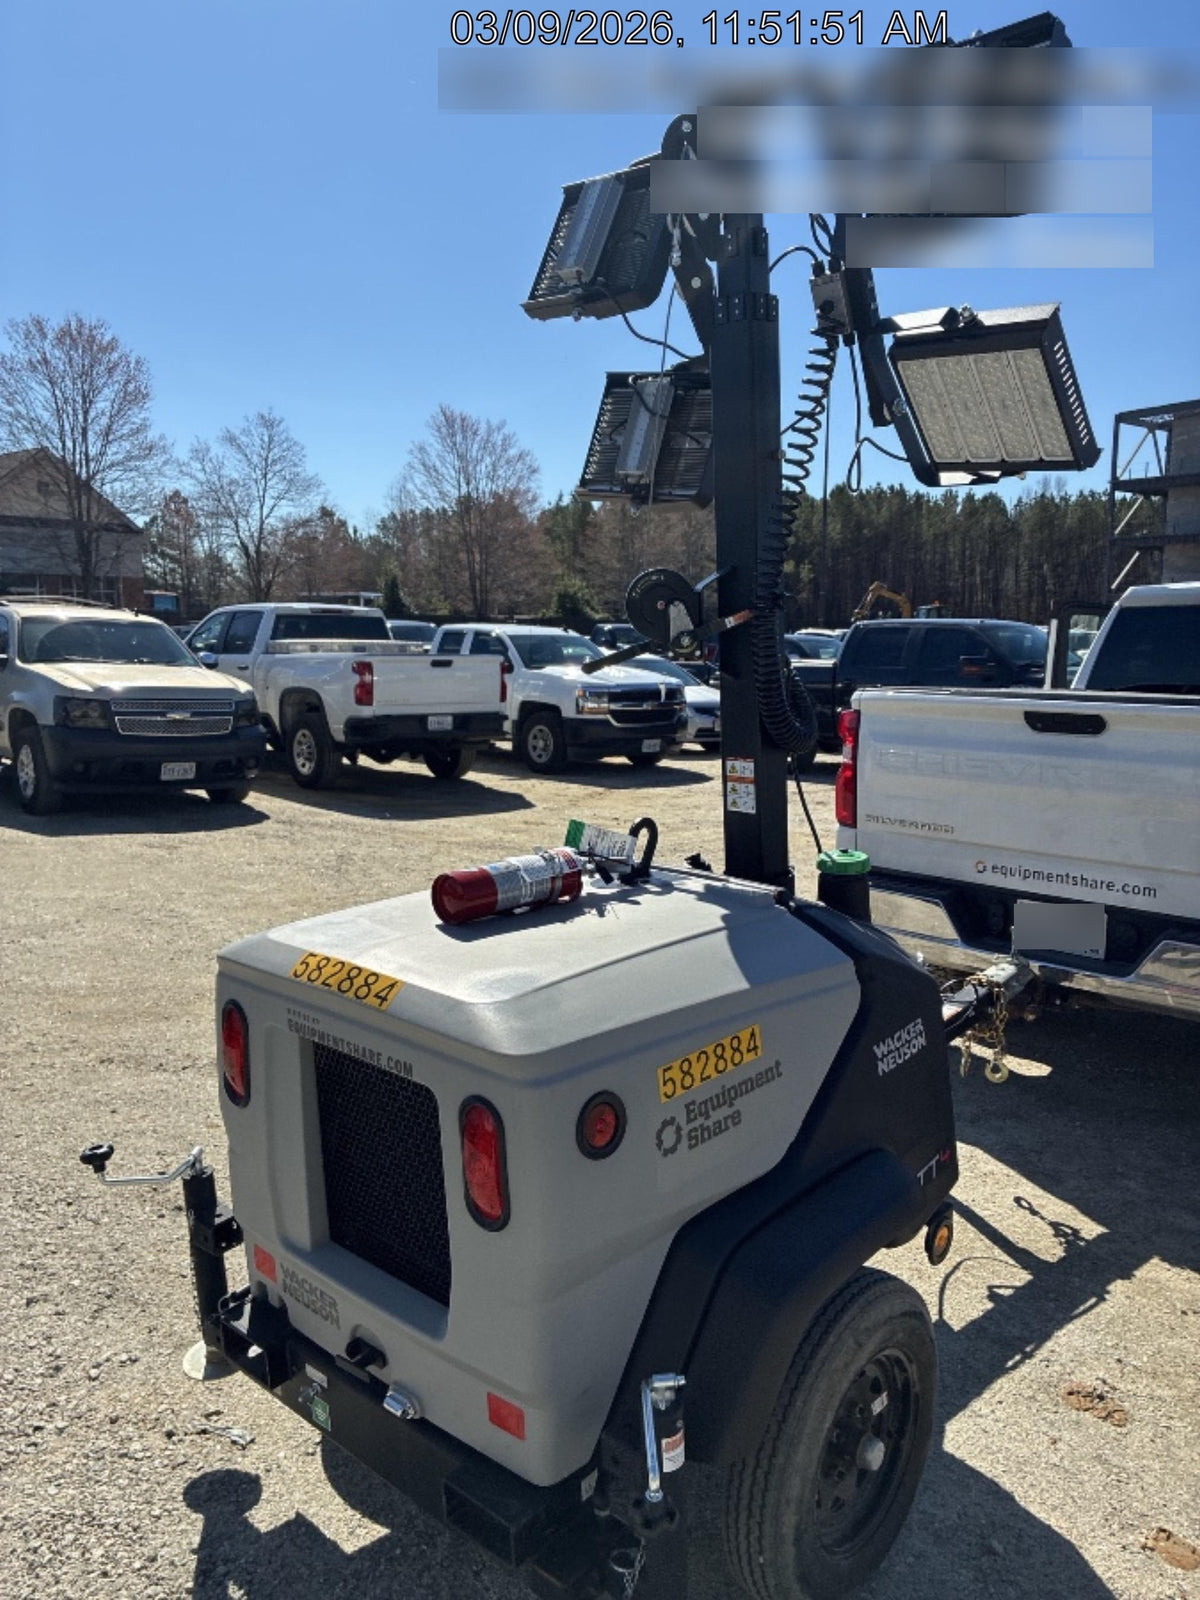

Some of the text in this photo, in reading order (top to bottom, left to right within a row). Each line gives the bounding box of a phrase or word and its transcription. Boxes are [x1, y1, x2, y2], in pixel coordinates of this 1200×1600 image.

[991, 864, 1158, 898] equipmentshare.com
[292, 952, 399, 1007] 582884
[287, 1018, 414, 1078] EQUIPMENTSHARE.COM
[662, 1027, 759, 1099] 582884
[872, 1017, 924, 1059] WACKER
[877, 1031, 926, 1076] NEUSON
[684, 1059, 783, 1125] Equipment
[687, 1108, 742, 1150] Share
[280, 1263, 338, 1313] WACKER
[282, 1278, 341, 1331] NEUSON
